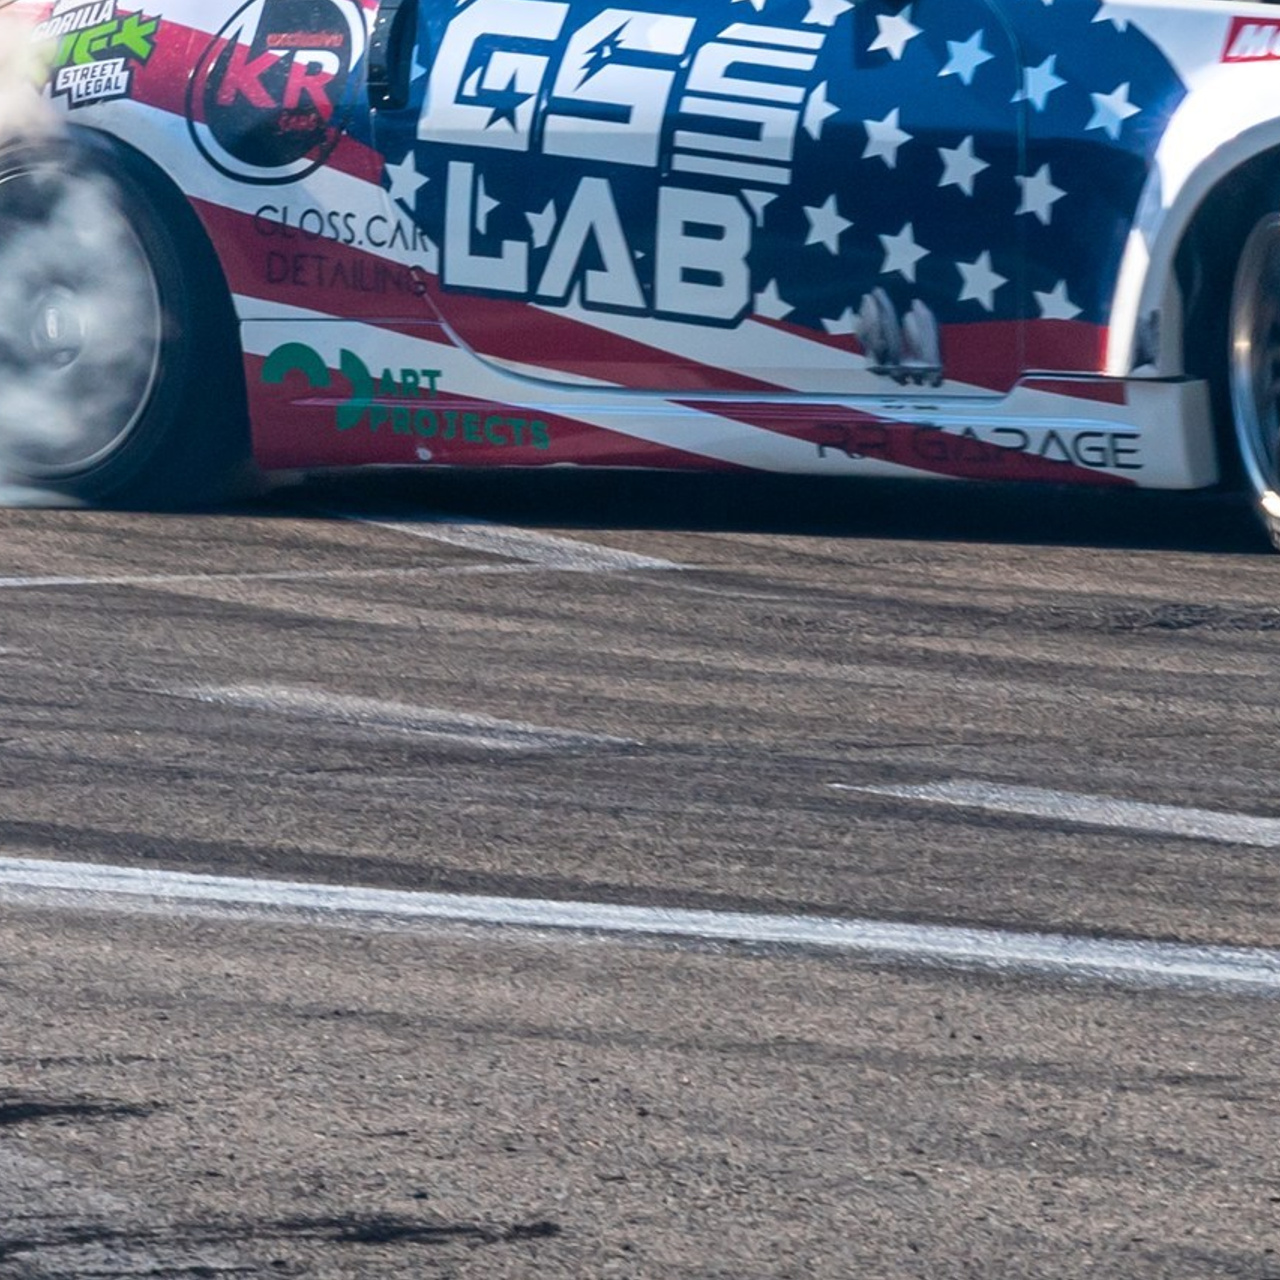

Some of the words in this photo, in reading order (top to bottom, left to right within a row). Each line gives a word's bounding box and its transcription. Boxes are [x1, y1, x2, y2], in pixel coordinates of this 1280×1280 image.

[62, 61, 119, 86] STREET
[76, 76, 122, 99] LEGAL
[217, 49, 340, 121] KR
[444, 161, 751, 320] LAB
[378, 368, 442, 398] ART
[370, 406, 551, 450] PROJECTS
[913, 422, 1143, 469] GARAGE
